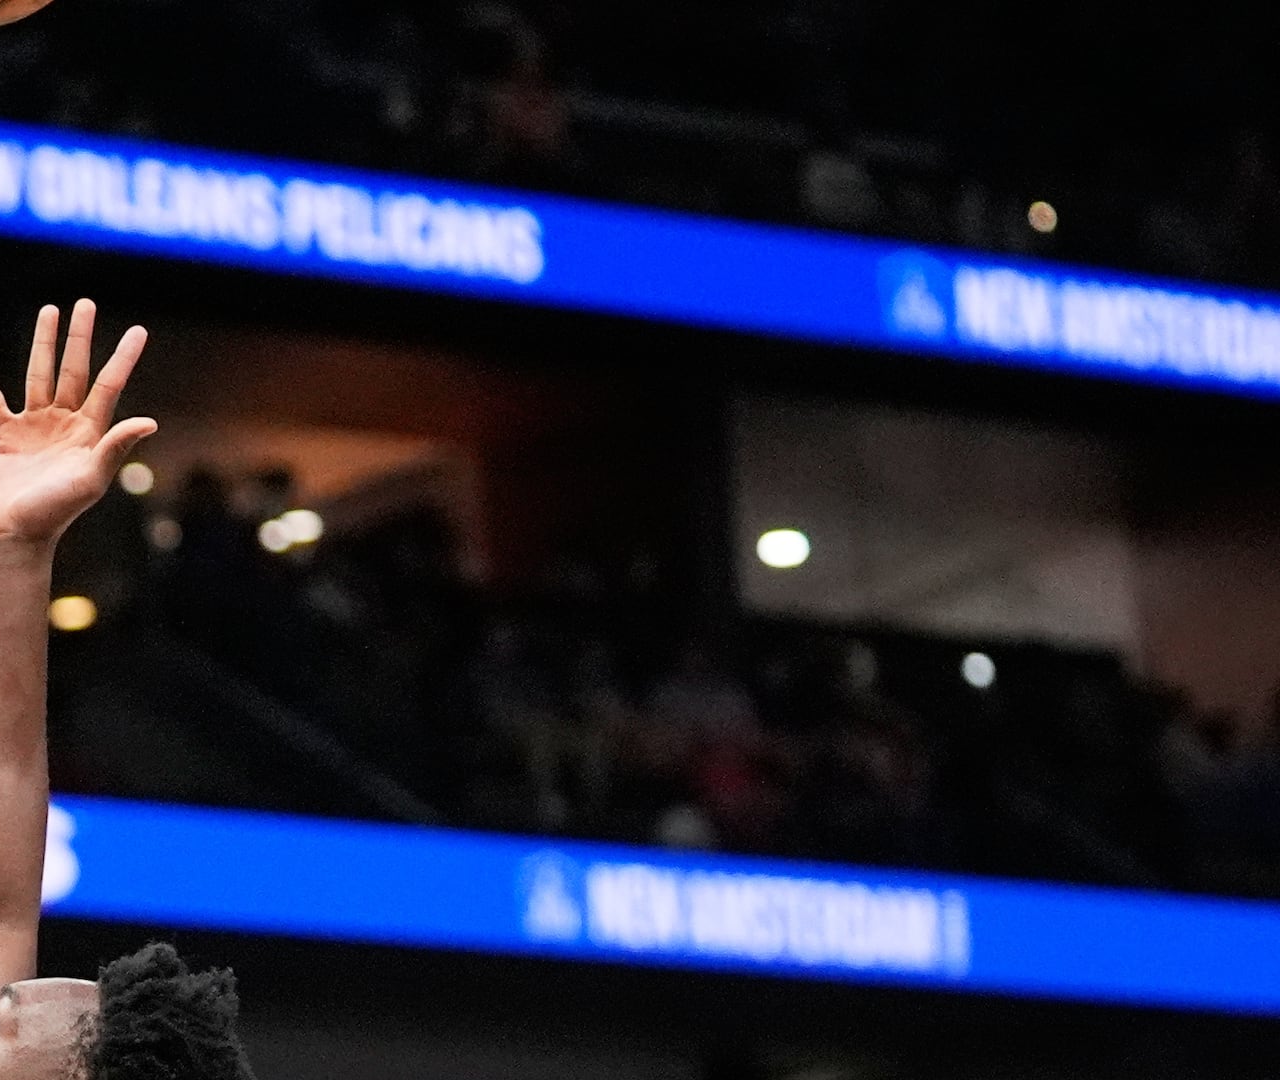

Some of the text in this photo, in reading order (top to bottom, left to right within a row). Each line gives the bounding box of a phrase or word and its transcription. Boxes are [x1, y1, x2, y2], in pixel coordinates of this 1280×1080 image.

[28, 145, 280, 251] ORLEANS
[282, 177, 544, 285] PELICANS
[954, 264, 1280, 385] NEW AMSTERDA
[586, 862, 680, 951] NEW
